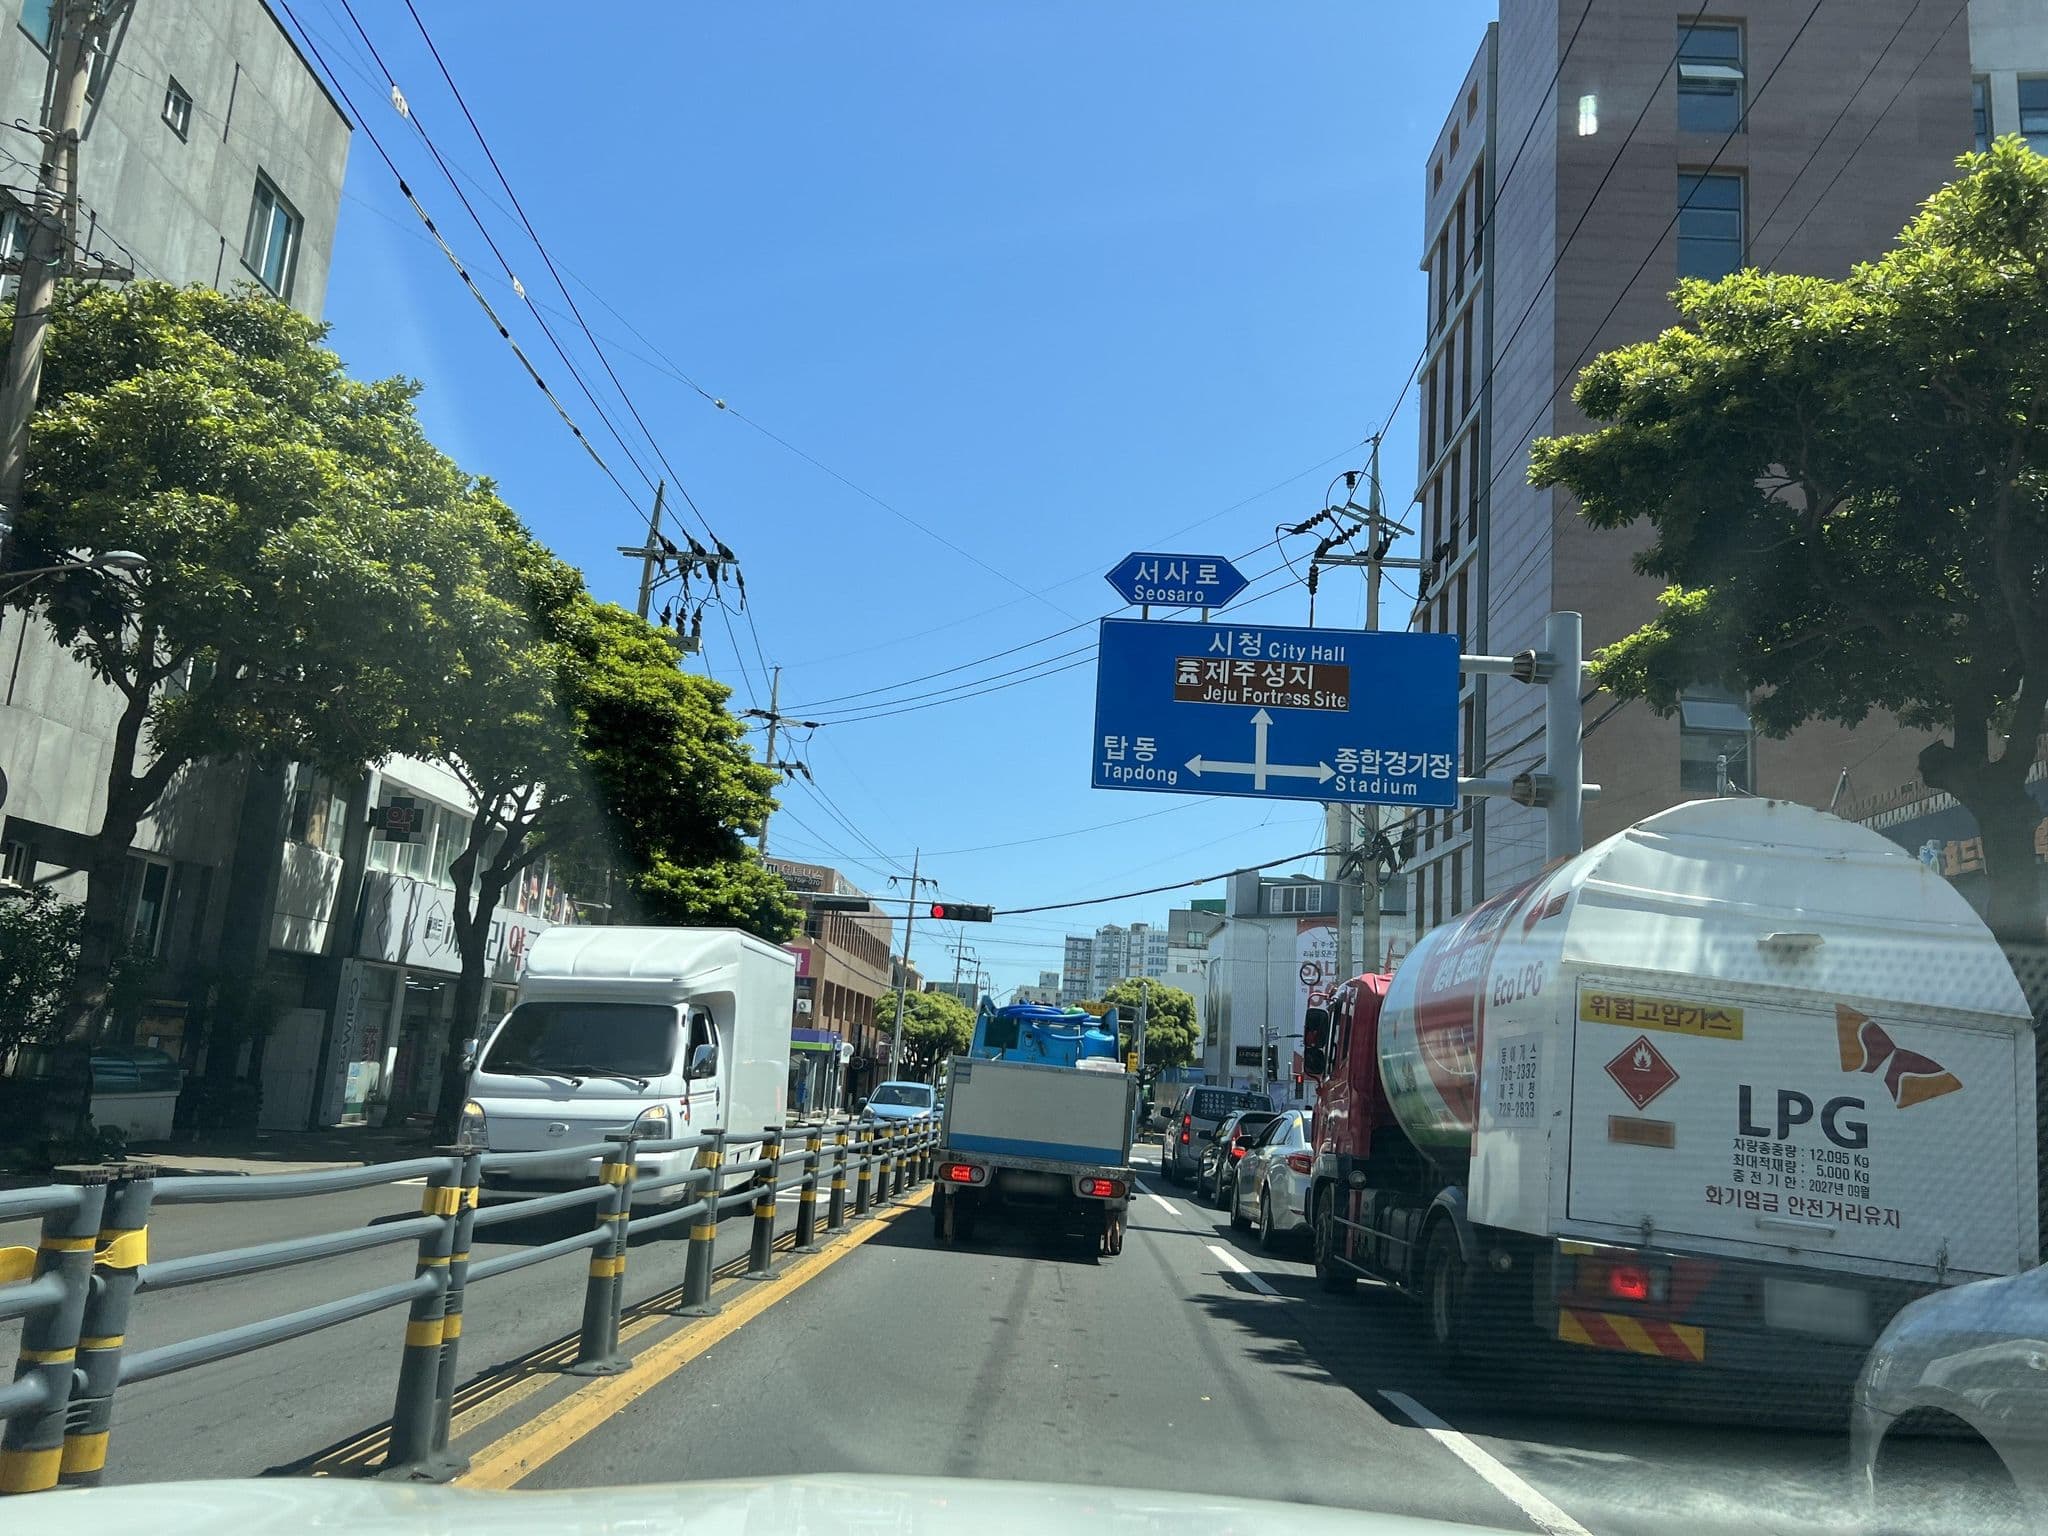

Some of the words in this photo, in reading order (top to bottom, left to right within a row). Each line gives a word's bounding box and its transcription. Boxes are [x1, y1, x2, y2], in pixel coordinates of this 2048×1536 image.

[1134, 560, 1220, 586] 서사로
[1134, 585, 1205, 603] Seosaro
[1208, 631, 1263, 657] 시청
[1268, 642, 1306, 662] City
[1310, 645, 1345, 662] Hall
[1204, 660, 1315, 690] 제주성지
[1203, 687, 1238, 704] Jeju
[1242, 688, 1310, 707] Fortress
[1314, 691, 1347, 709] Site
[1104, 735, 1158, 762] 탑동
[1103, 762, 1178, 785] Tapdong
[1334, 747, 1453, 779] 종합경기장
[1335, 775, 1418, 797] Stadium
[1493, 974, 1513, 1007] Eco
[1516, 960, 1545, 1001] LPG
[1590, 994, 1732, 1030] 위험고압가스
[1738, 1084, 1869, 1149] LPG
[1732, 1153, 1797, 1174] 최대적재량
[1854, 1169, 1870, 1184] Kg
[1854, 1153, 1870, 1169] Kg
[1809, 1179, 1844, 1196] 2027년
[1847, 1184, 1871, 1200] 09월
[1705, 1184, 1779, 1213] 화기엄금
[1788, 1195, 1901, 1229] 안전거리유지
